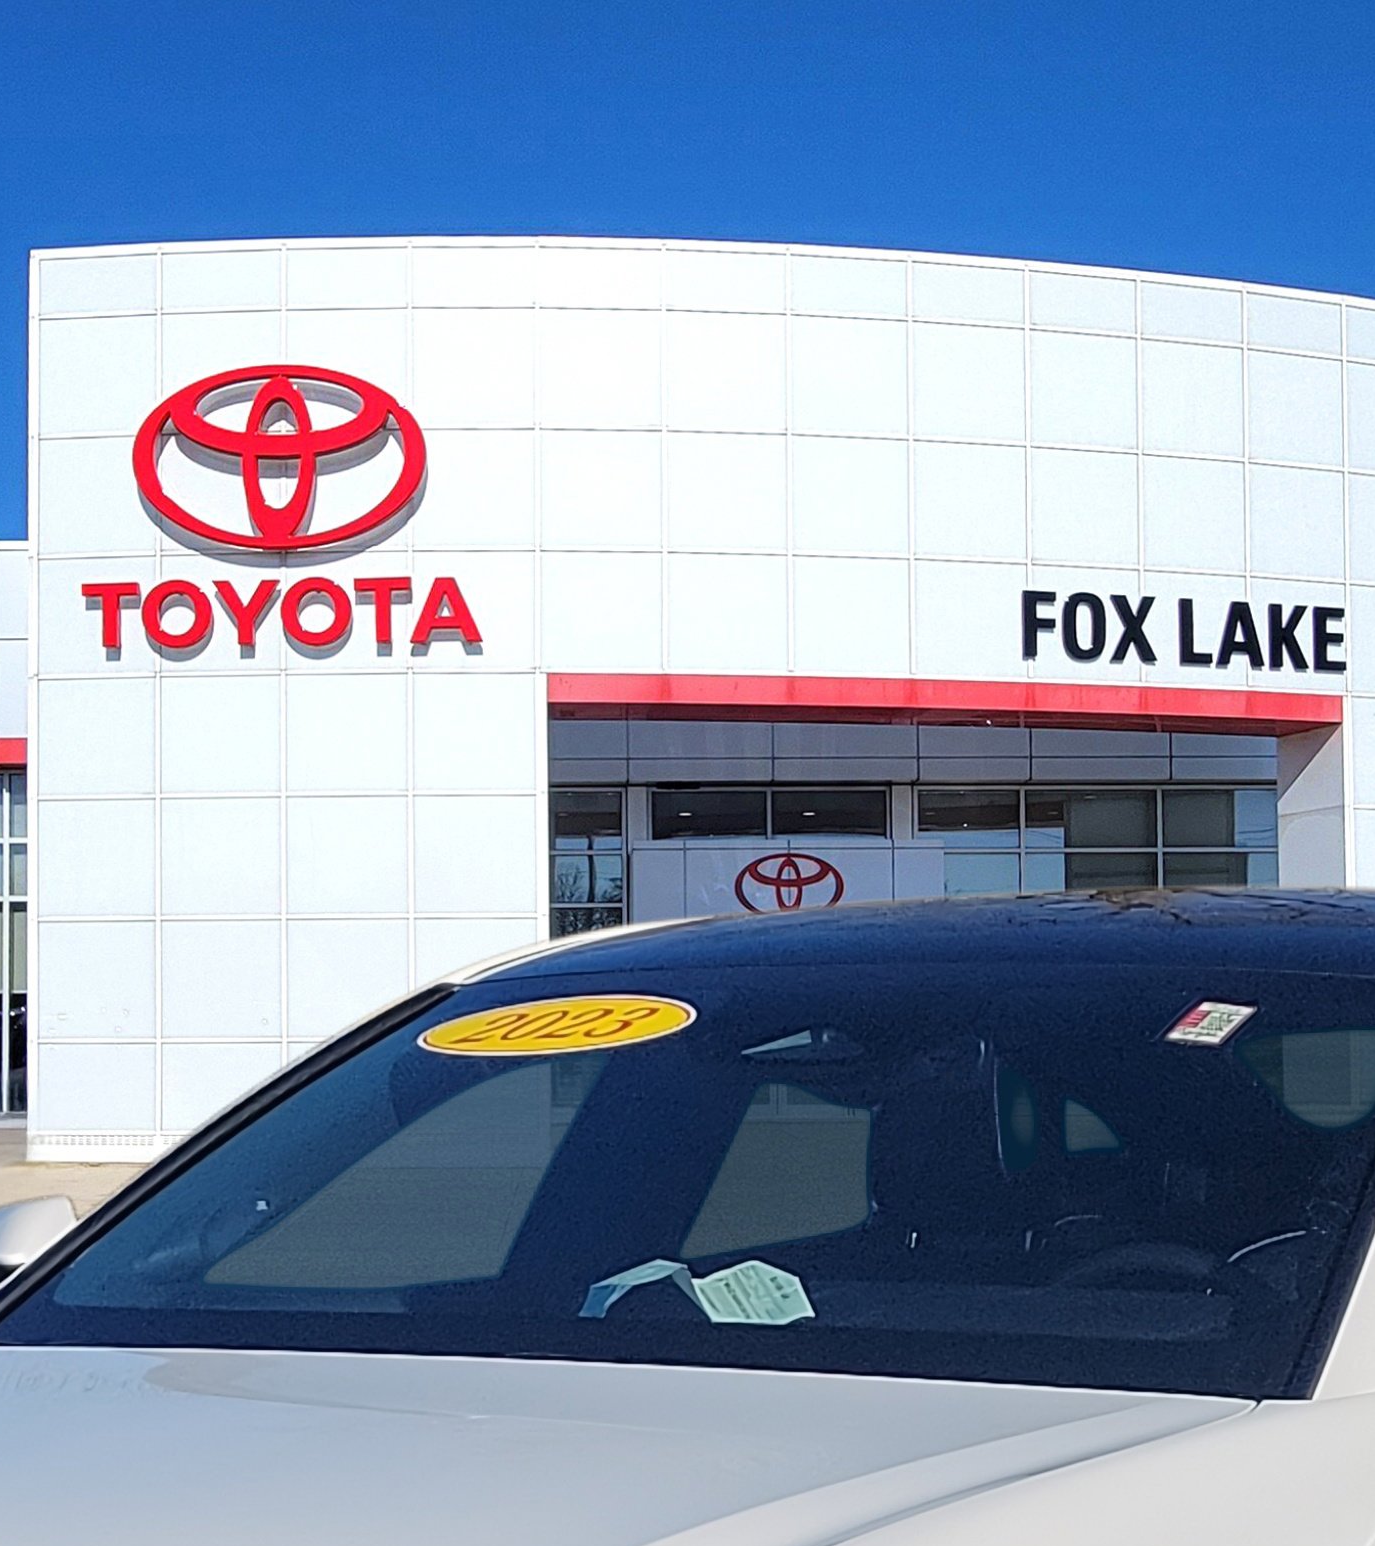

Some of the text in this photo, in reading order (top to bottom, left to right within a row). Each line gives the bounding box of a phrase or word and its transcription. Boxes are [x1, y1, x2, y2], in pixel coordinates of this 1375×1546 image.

[82, 576, 483, 661] TOYOTA
[1022, 589, 1347, 673] FOX LAKE
[448, 1007, 661, 1045] 2023
